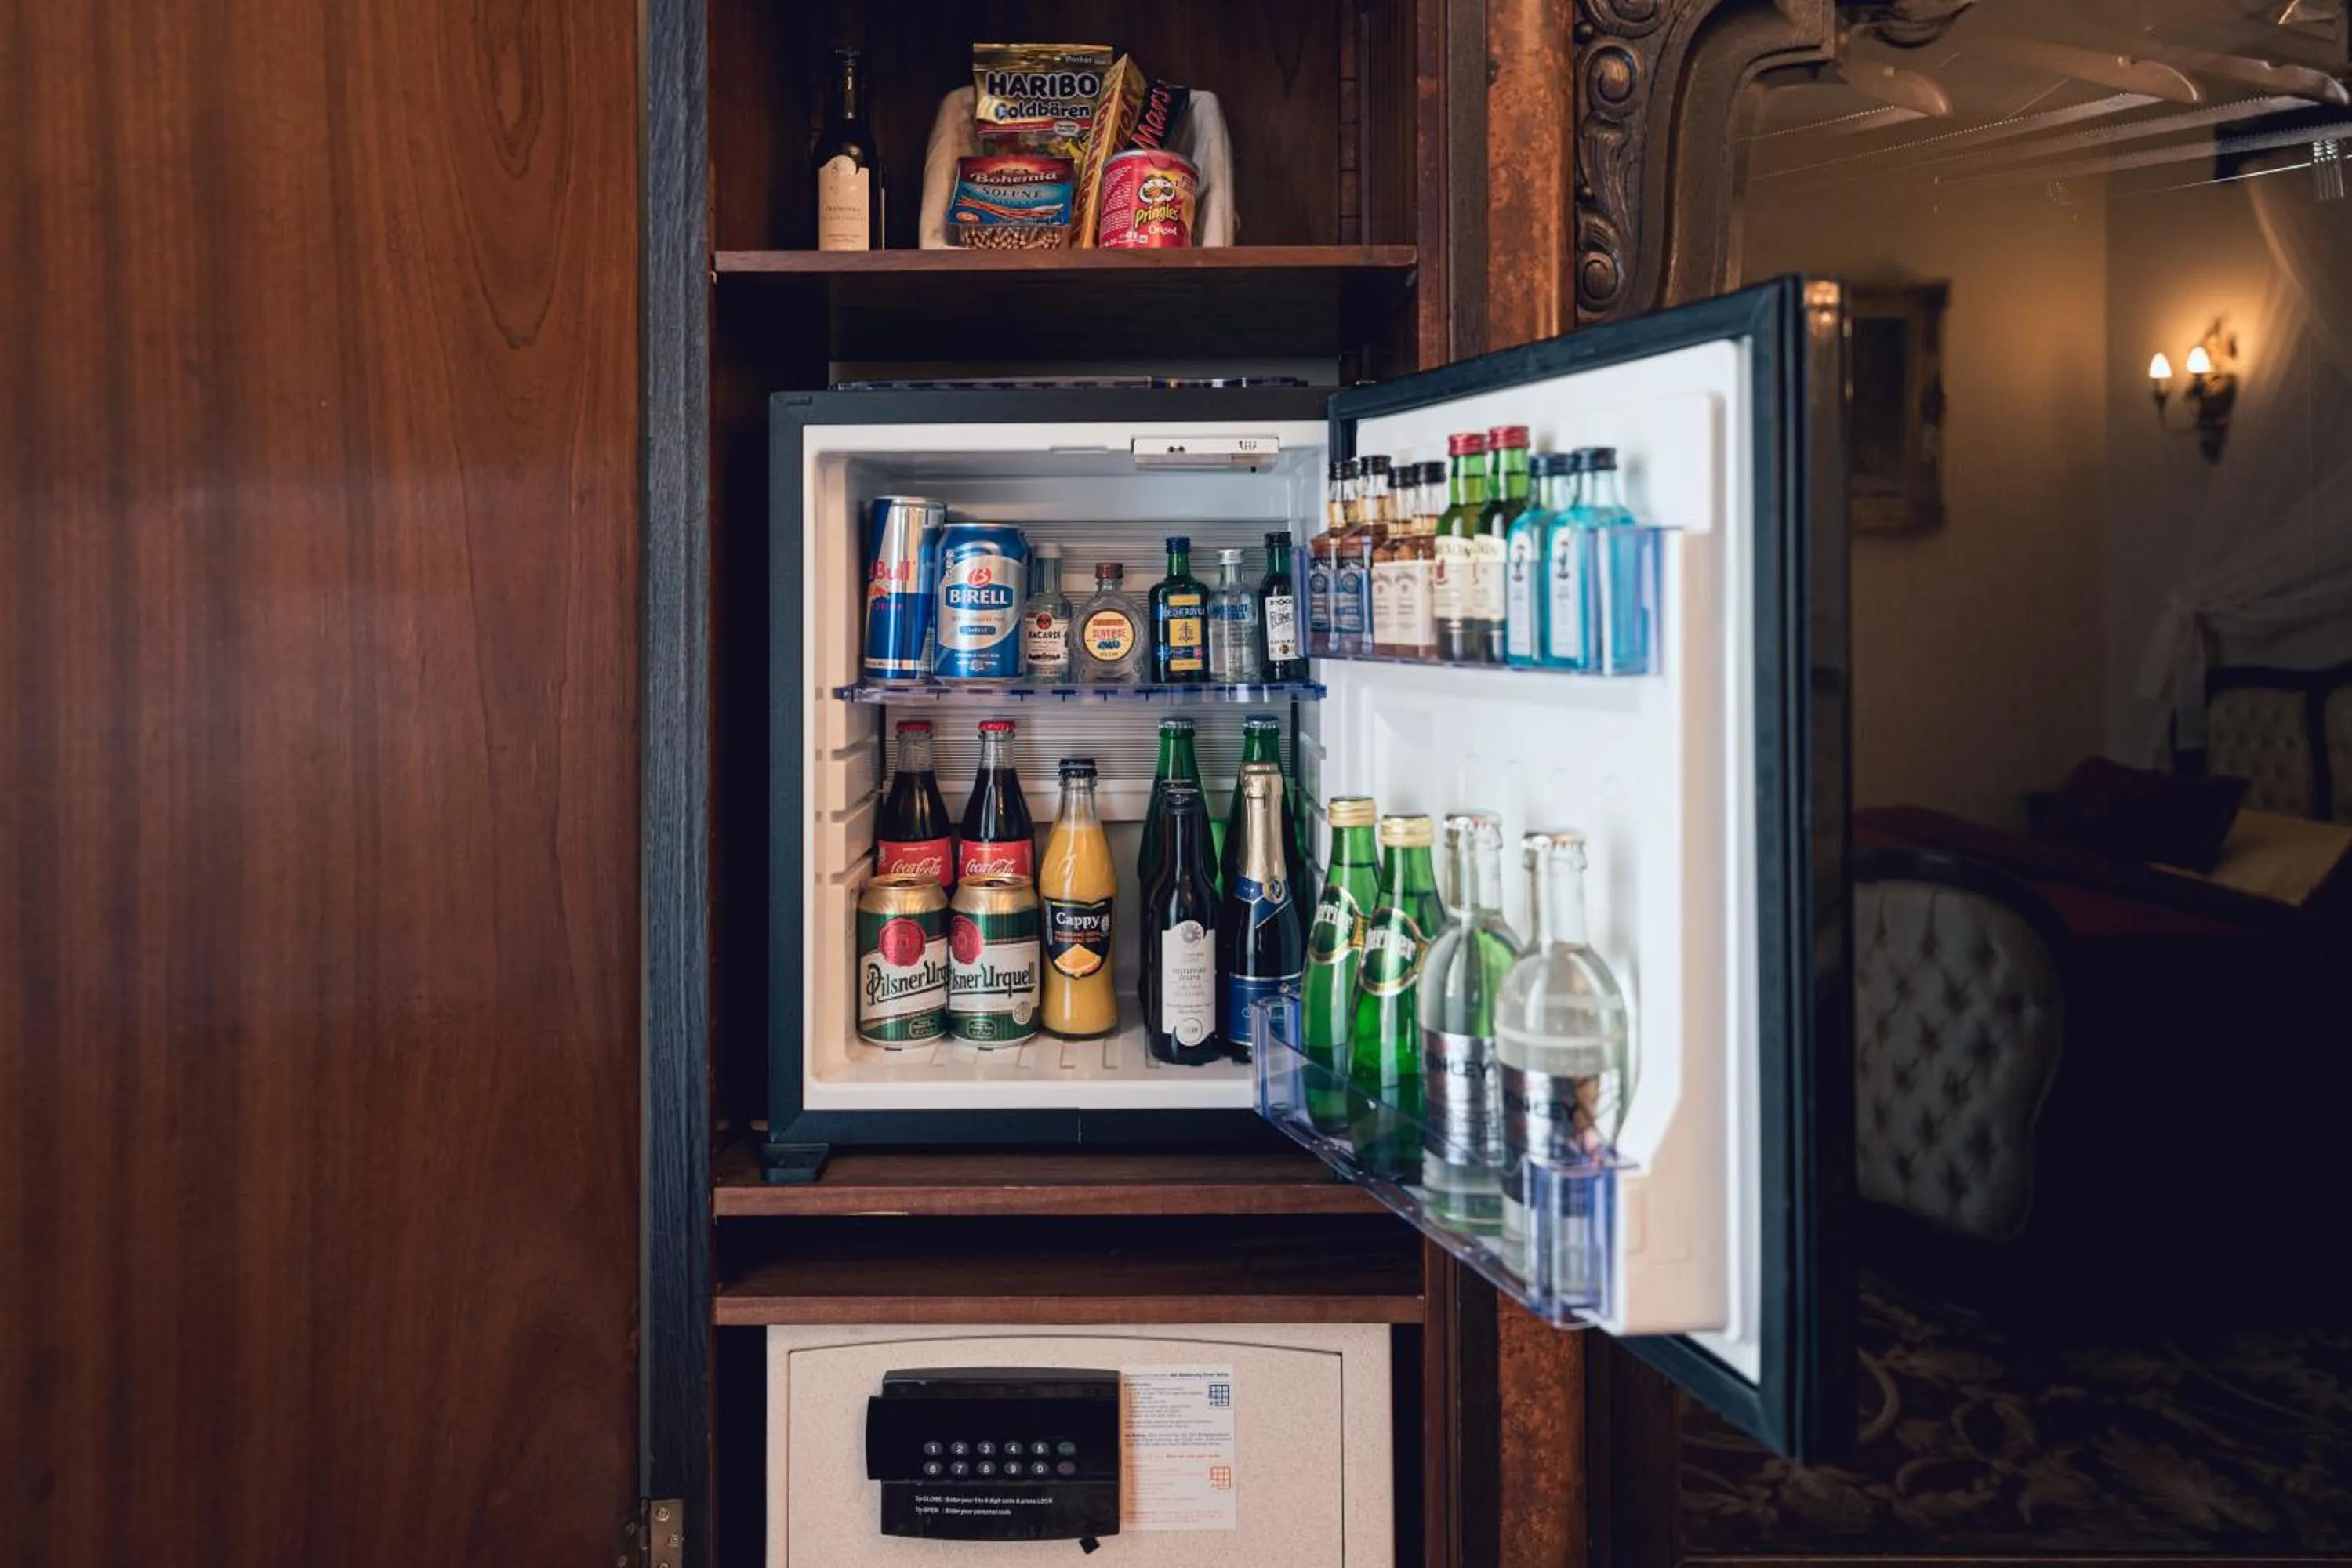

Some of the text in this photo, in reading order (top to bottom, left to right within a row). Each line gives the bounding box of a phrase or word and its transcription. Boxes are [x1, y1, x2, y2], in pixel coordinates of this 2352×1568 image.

[986, 71, 1099, 99] HARIBO
[994, 100, 1091, 121] Goldbären
[970, 172, 1058, 183] Bohemia
[1134, 202, 1179, 230] Pringles
[949, 589, 1008, 605] BIRELL
[1055, 911, 1100, 930] Cappy
[866, 963, 926, 1007] Pilsner
[980, 961, 1037, 999] Urquell
[956, 1444, 964, 1454] 2
[983, 1443, 990, 1454] 3
[1037, 1444, 1044, 1453] 5
[929, 1465, 936, 1474] 6
[956, 1464, 964, 1474] 7
[1036, 1464, 1044, 1474] 0
